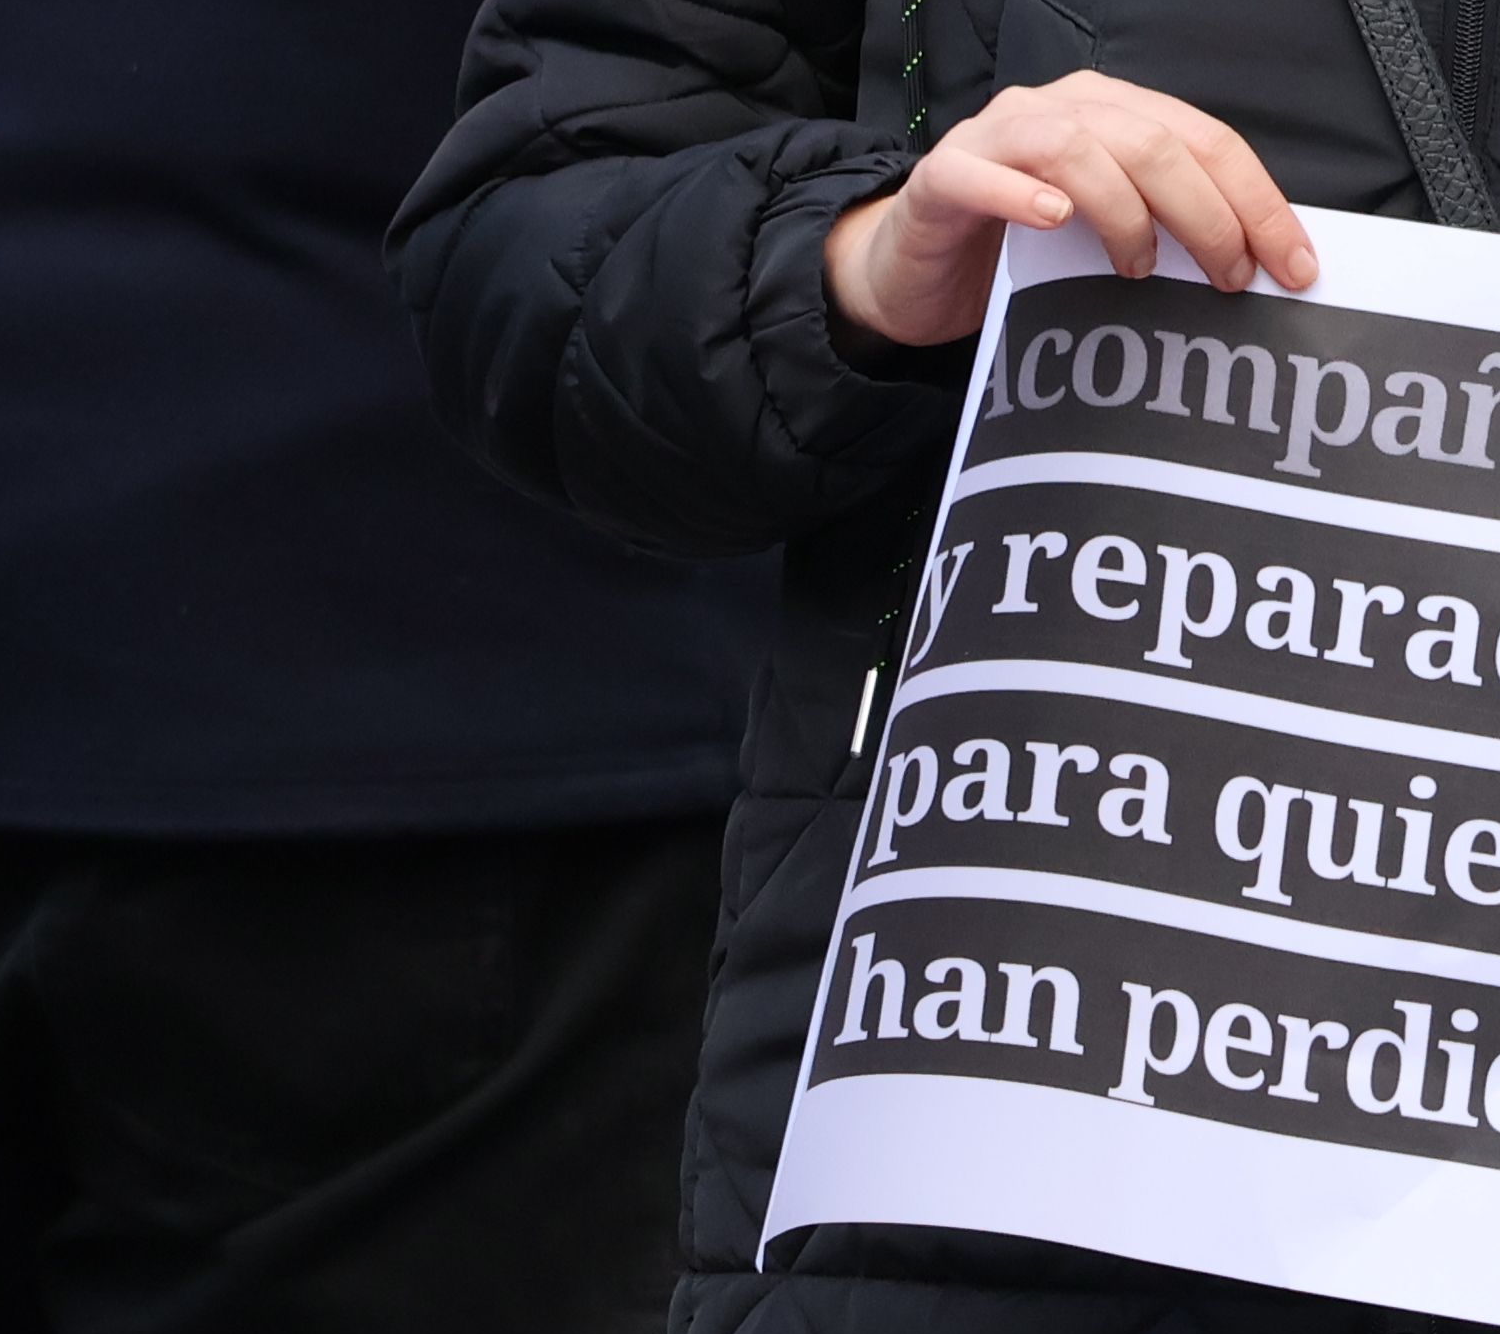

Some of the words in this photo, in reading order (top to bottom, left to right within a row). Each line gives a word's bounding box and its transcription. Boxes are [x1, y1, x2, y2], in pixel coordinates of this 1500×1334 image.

[910, 542, 975, 668] y
[866, 738, 1173, 869] para
[833, 932, 1084, 1056] han
